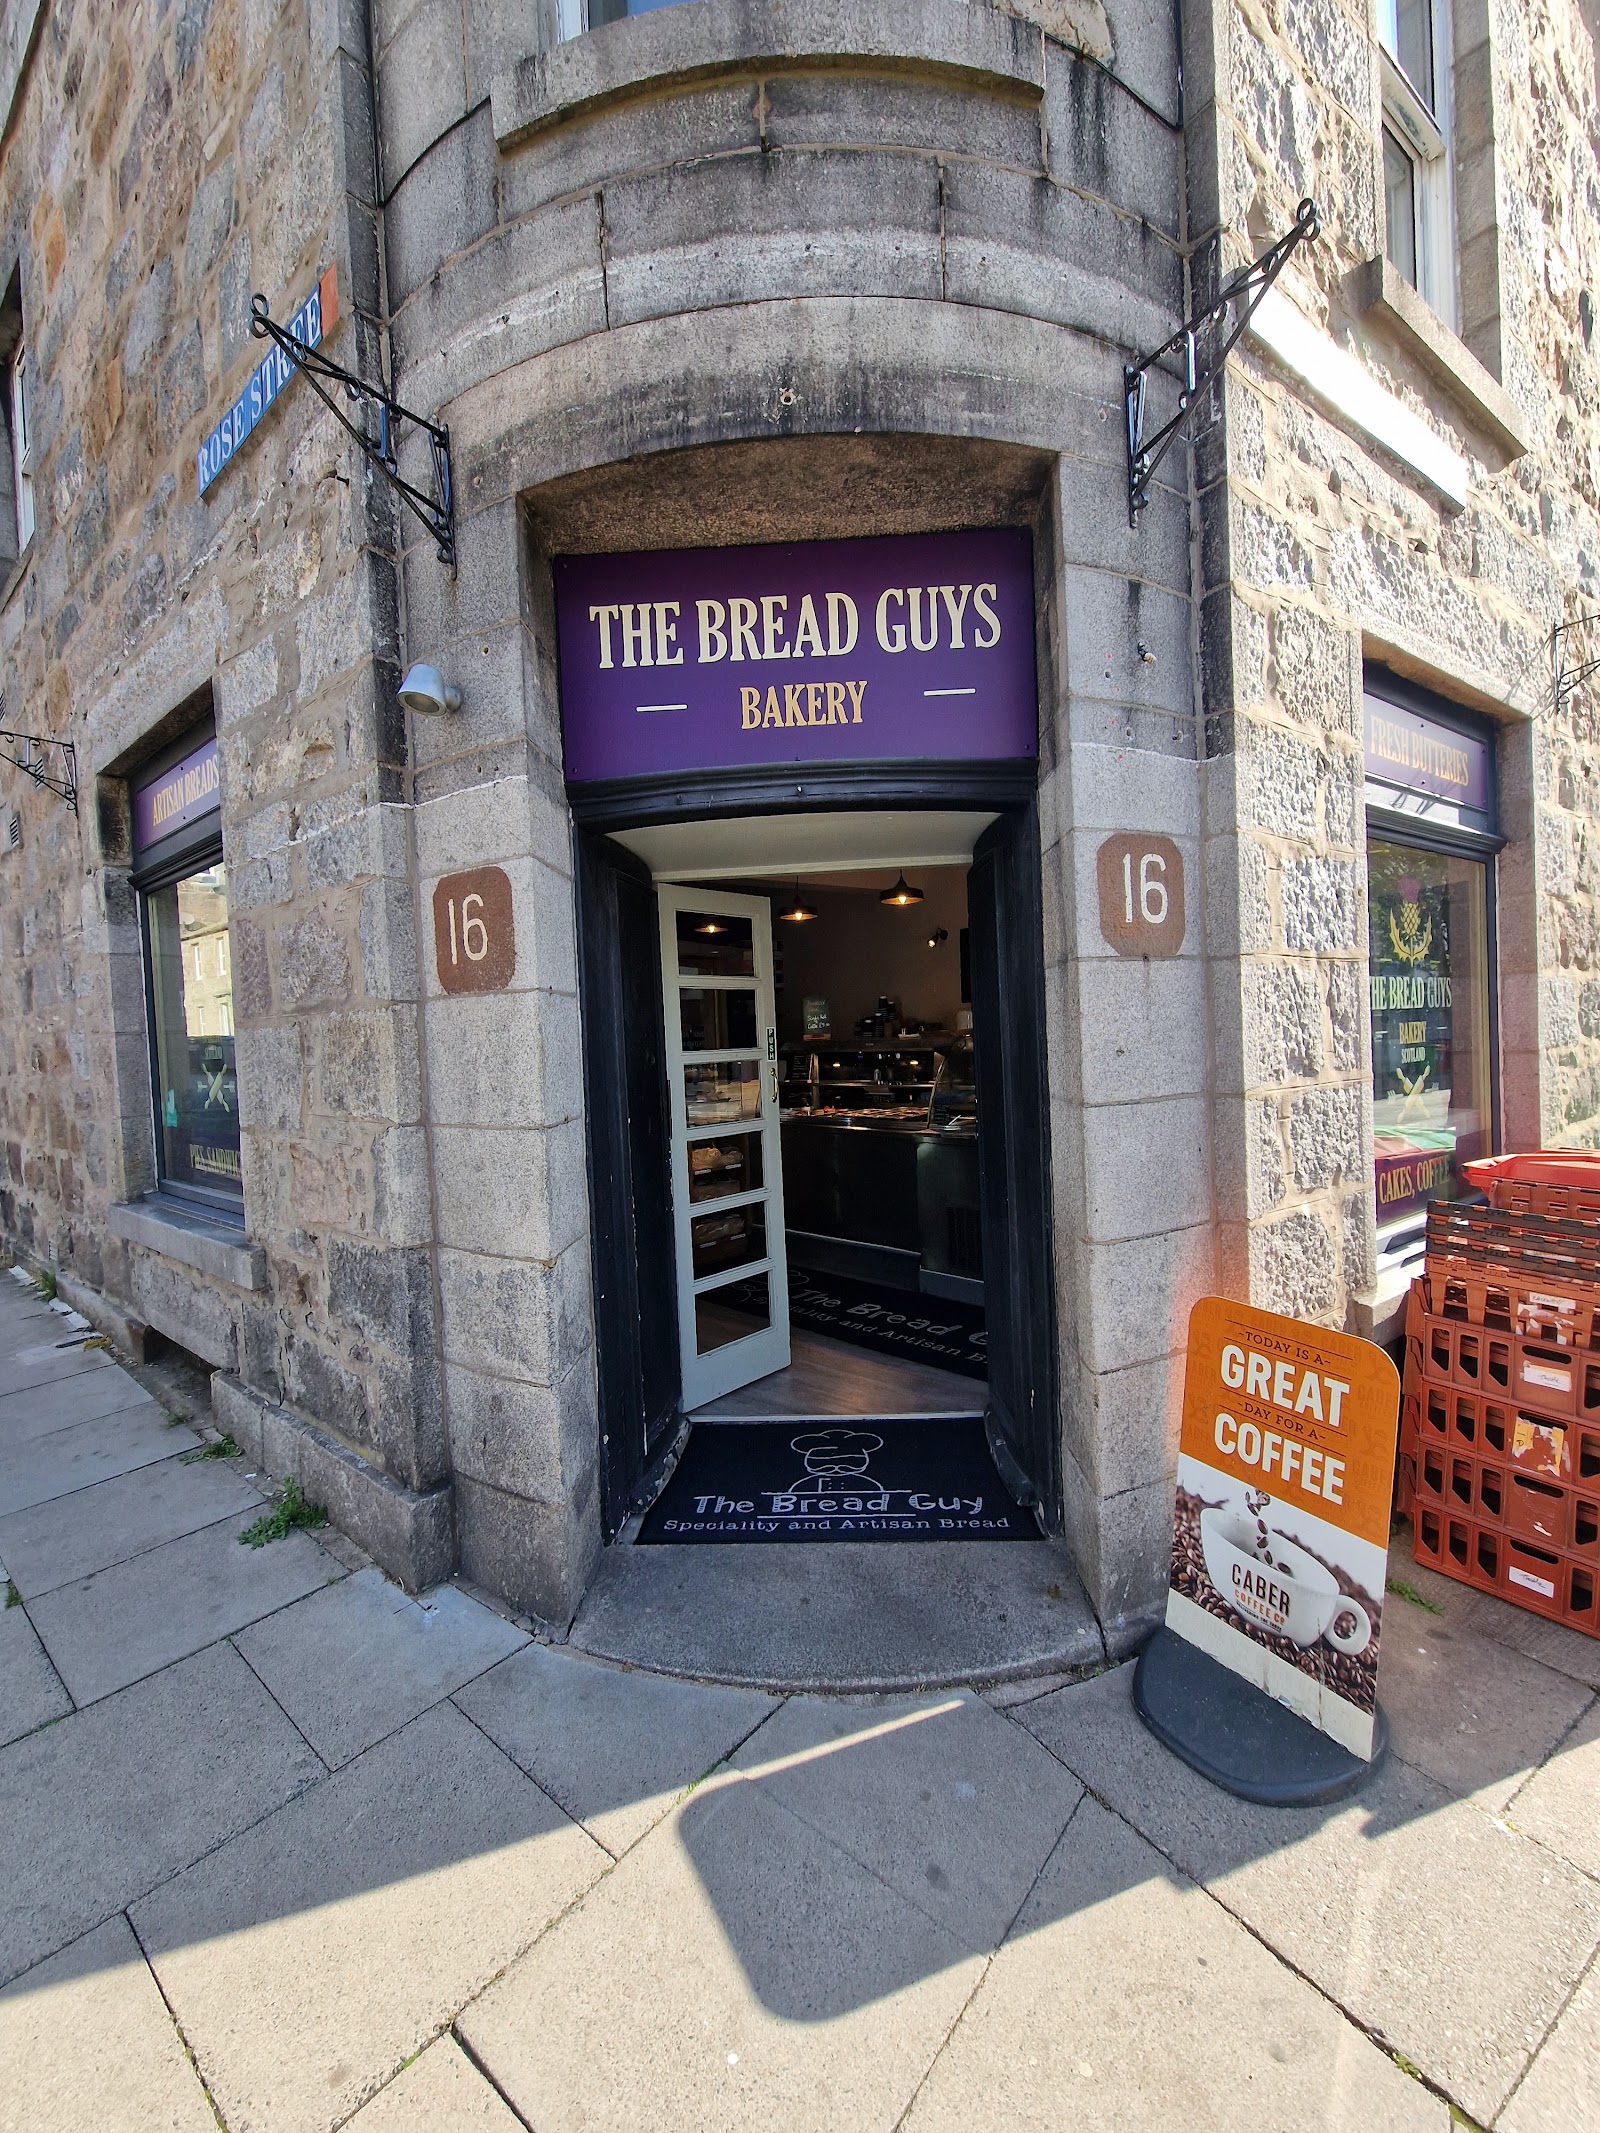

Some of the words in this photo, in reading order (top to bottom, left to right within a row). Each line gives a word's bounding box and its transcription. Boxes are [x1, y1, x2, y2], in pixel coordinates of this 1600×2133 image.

[199, 399, 245, 487] ROSE
[589, 601, 684, 669] THE
[695, 592, 859, 664] BREAD
[875, 583, 1002, 654] GUYS
[740, 680, 868, 730] BAKERY
[1371, 715, 1410, 766] FRESH
[1411, 731, 1469, 786] BUTTERIES
[153, 777, 185, 827] ARTISAN
[184, 754, 220, 806] BREADS
[1123, 853, 1168, 924] 16
[448, 893, 489, 965] 16
[1388, 976, 1424, 1009] BREAD
[1426, 976, 1452, 1008] GUYS
[1399, 1021, 1427, 1045] BAKERY
[1401, 1046, 1426, 1063] SCOTLAND
[1379, 1165, 1416, 1205] CAKES,
[791, 1289, 842, 1308] The
[846, 1302, 963, 1336] Bread
[839, 1320, 878, 1333] and
[878, 1330, 962, 1356] Artisan
[1296, 1347, 1309, 1360] IS
[1220, 1344, 1350, 1427] GREAT
[1275, 1415, 1304, 1434] FOR
[1214, 1412, 1346, 1506] COFFEE
[663, 1519, 780, 1533] Speciality
[788, 1518, 832, 1530] and
[839, 1518, 931, 1530] Artisan
[939, 1517, 1010, 1529] Bread
[693, 1495, 755, 1515] The
[773, 1493, 889, 1513] Bread
[909, 1493, 983, 1515] Guy
[1231, 1563, 1290, 1618] CABER
[1234, 1589, 1271, 1619] COFFEE
